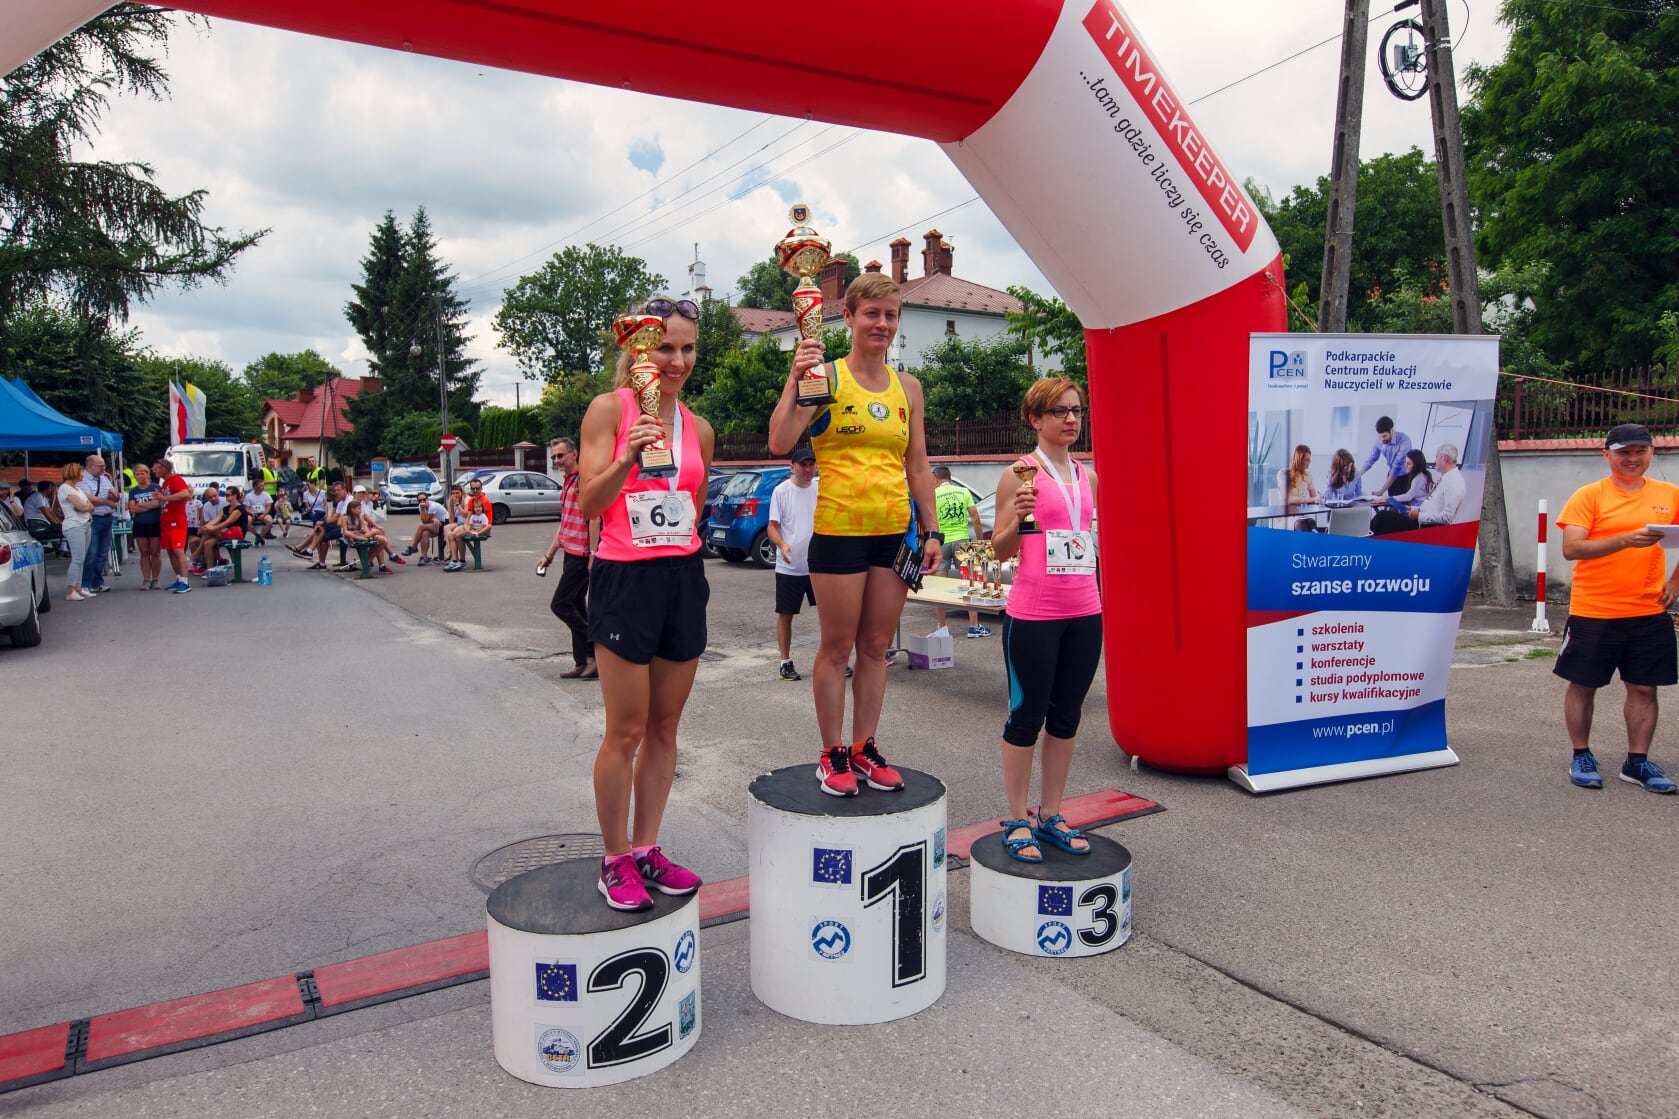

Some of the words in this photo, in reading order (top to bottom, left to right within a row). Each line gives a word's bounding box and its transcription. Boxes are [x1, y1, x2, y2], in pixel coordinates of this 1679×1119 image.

[1105, 10, 1250, 233] TIMEKEEPER
[1114, 117, 1155, 166] gdzie
[1150, 162, 1185, 208] liczy
[1180, 206, 1203, 235] się
[1199, 232, 1230, 269] czas
[1326, 350, 1396, 364] Podkarpackie
[1325, 365, 1369, 377] Centrum
[1372, 364, 1417, 379] Edukacji
[1324, 379, 1383, 393] Nauczycieli
[1386, 382, 1395, 390] w
[1398, 379, 1452, 391] Rzeszowie
[1291, 553, 1373, 570] Stwarzamy
[1291, 579, 1352, 596] szanse
[1357, 574, 1431, 597] rozwoju
[1311, 622, 1365, 636] szkolenia
[1311, 638, 1365, 653] warsztaty
[1311, 655, 1376, 670] konferencje
[1310, 672, 1344, 686] studia
[1346, 670, 1425, 686] podyplomowe
[1310, 690, 1339, 704] kursy
[1342, 686, 1421, 701] kwalifikacyjne
[1312, 718, 1395, 739] www.pcen.pl
[860, 839, 927, 989] 1
[1077, 883, 1118, 947] 3
[586, 946, 674, 1070] 2
